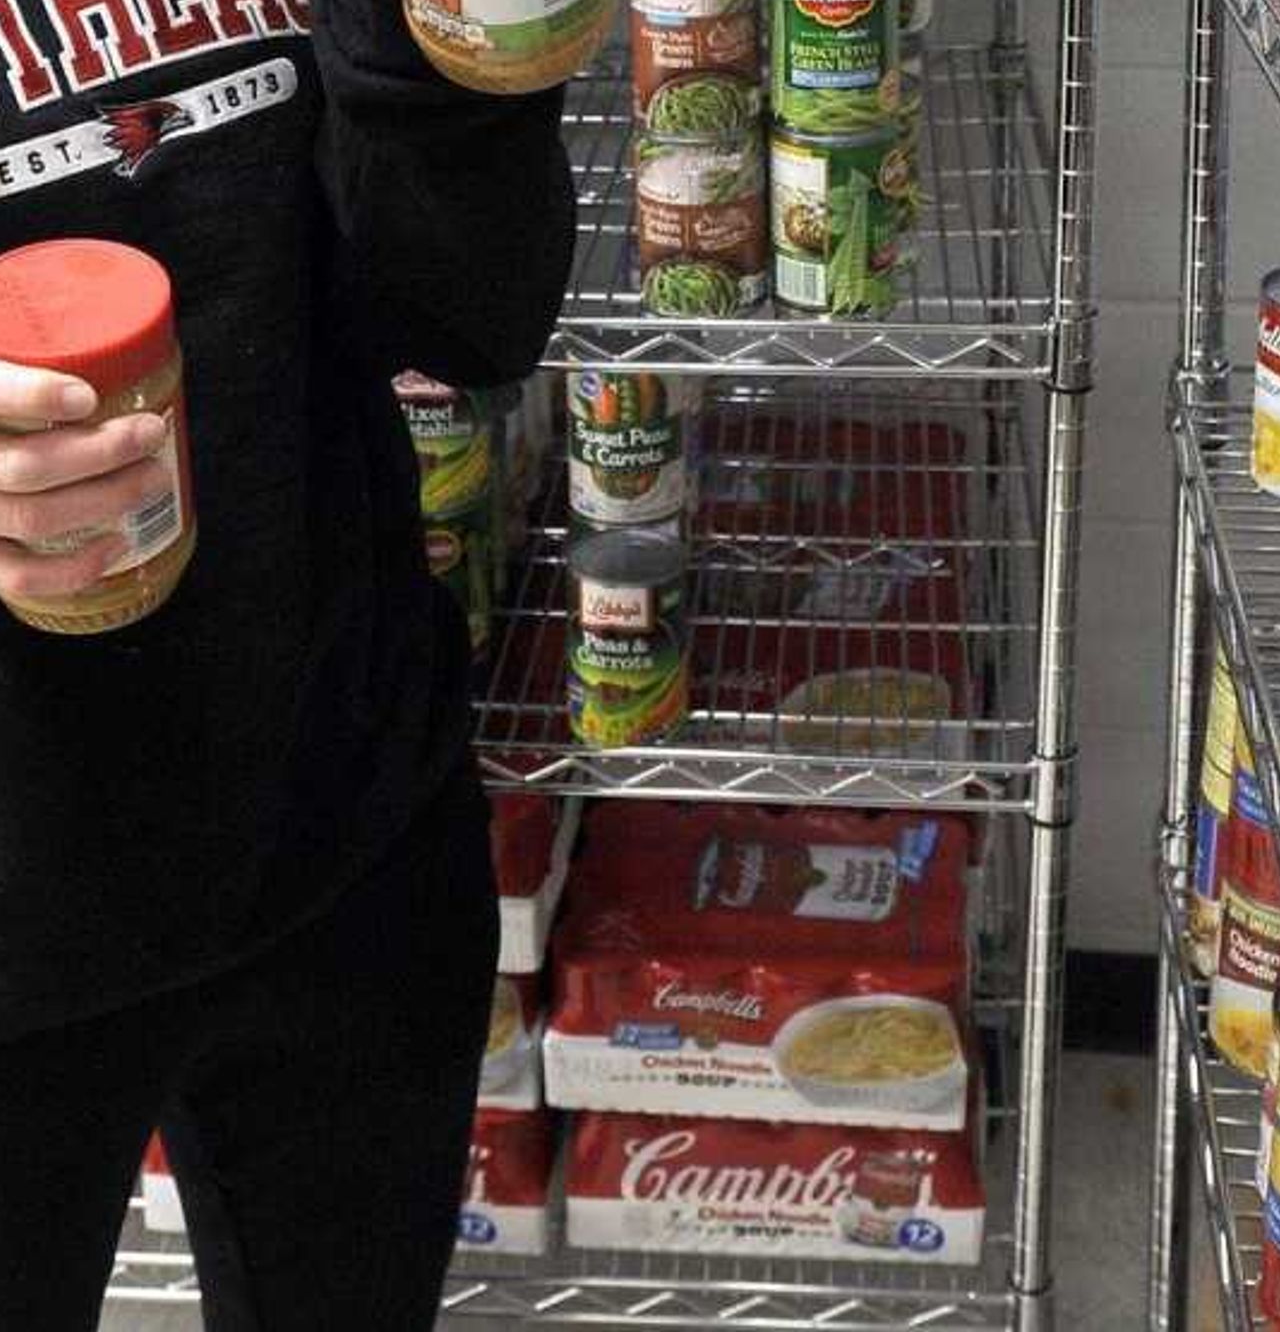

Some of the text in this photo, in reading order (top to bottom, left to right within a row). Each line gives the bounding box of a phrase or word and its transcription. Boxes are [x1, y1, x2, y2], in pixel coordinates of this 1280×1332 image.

[205, 72, 280, 114] 1873
[401, 403, 453, 422] ixed
[574, 421, 670, 448] Sweet Peas
[582, 444, 665, 467] & Carrots
[583, 631, 629, 654] Peas
[577, 645, 654, 670] Carrots
[652, 981, 763, 1019] Campbell's
[641, 1054, 706, 1069] Chicken
[677, 1073, 738, 1088] SOUP
[905, 1221, 938, 1243] 12
